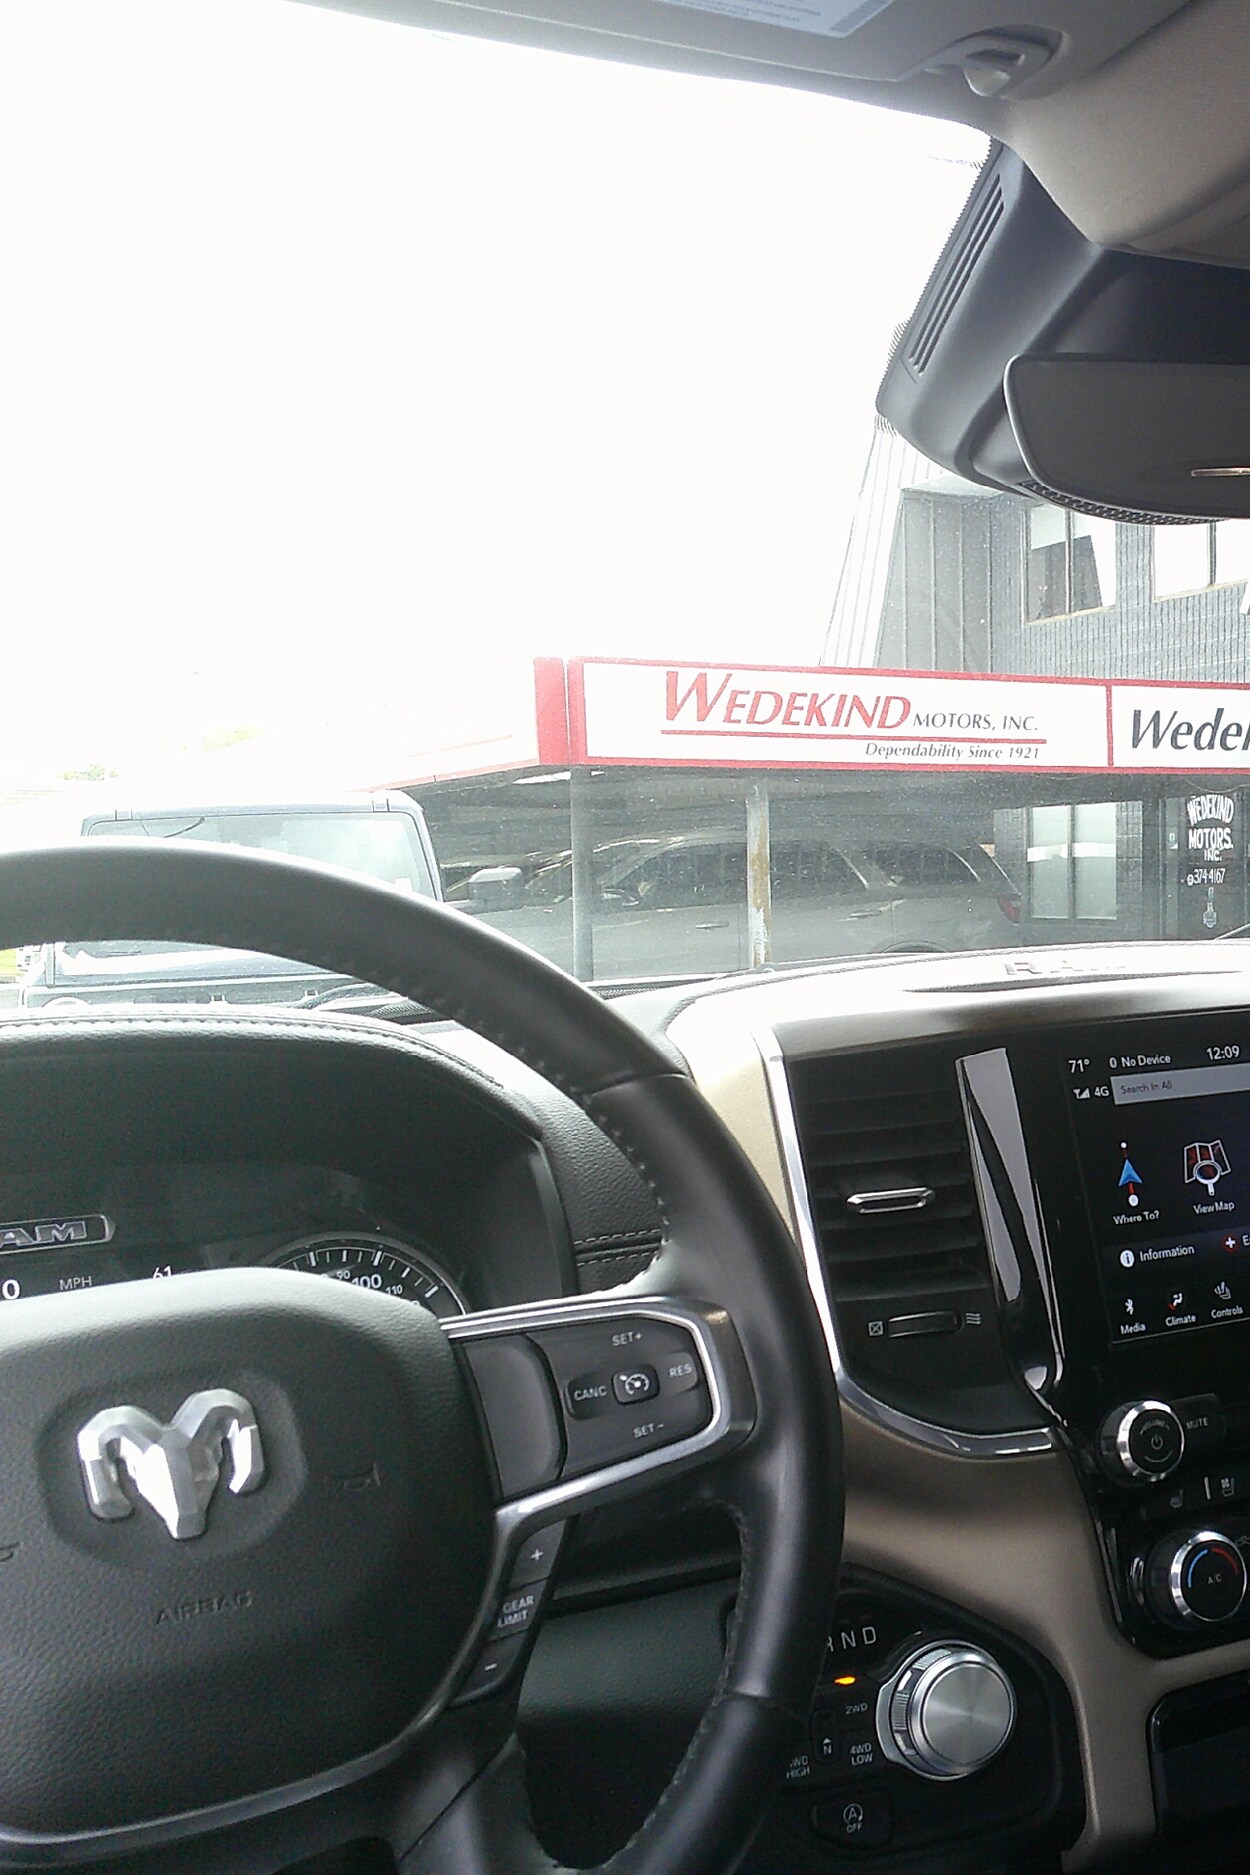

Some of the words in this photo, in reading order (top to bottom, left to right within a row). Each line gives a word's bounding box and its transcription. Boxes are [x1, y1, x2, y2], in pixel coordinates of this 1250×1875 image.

[665, 671, 911, 730] WEDEKIND
[912, 712, 997, 731] MOTORS,
[1002, 716, 1038, 731] INC.
[865, 742, 963, 761] Dependability
[967, 746, 1003, 759] Since
[1009, 747, 1039, 759] 1921
[1187, 794, 1235, 826] WEDEKIND
[1206, 1045, 1240, 1060] 12:09
[1121, 1056, 1136, 1067] No
[1137, 1054, 1171, 1066] Device
[1094, 1085, 1110, 1097] 4G
[1120, 1083, 1149, 1095] Search
[1193, 1203, 1214, 1215] View
[1214, 1200, 1235, 1213] Map
[1113, 1212, 1142, 1225] Where
[1143, 1209, 1160, 1221] To?
[0, 1220, 87, 1248] AM
[1139, 1244, 1195, 1262] Information
[59, 1276, 93, 1290] MPH
[1211, 1304, 1244, 1319] Controls
[1165, 1312, 1197, 1327] Climate
[1120, 1321, 1146, 1335] Media
[668, 1363, 693, 1378] RES
[573, 1385, 608, 1401] CANC
[1186, 1417, 1209, 1430] MUTE
[502, 1595, 534, 1614] GEAR
[497, 1609, 528, 1628] LIMIT
[845, 1703, 868, 1715] 2WD
[849, 1742, 872, 1754] 4WD
[850, 1753, 874, 1766] LOW
[846, 1822, 863, 1833] OFF
